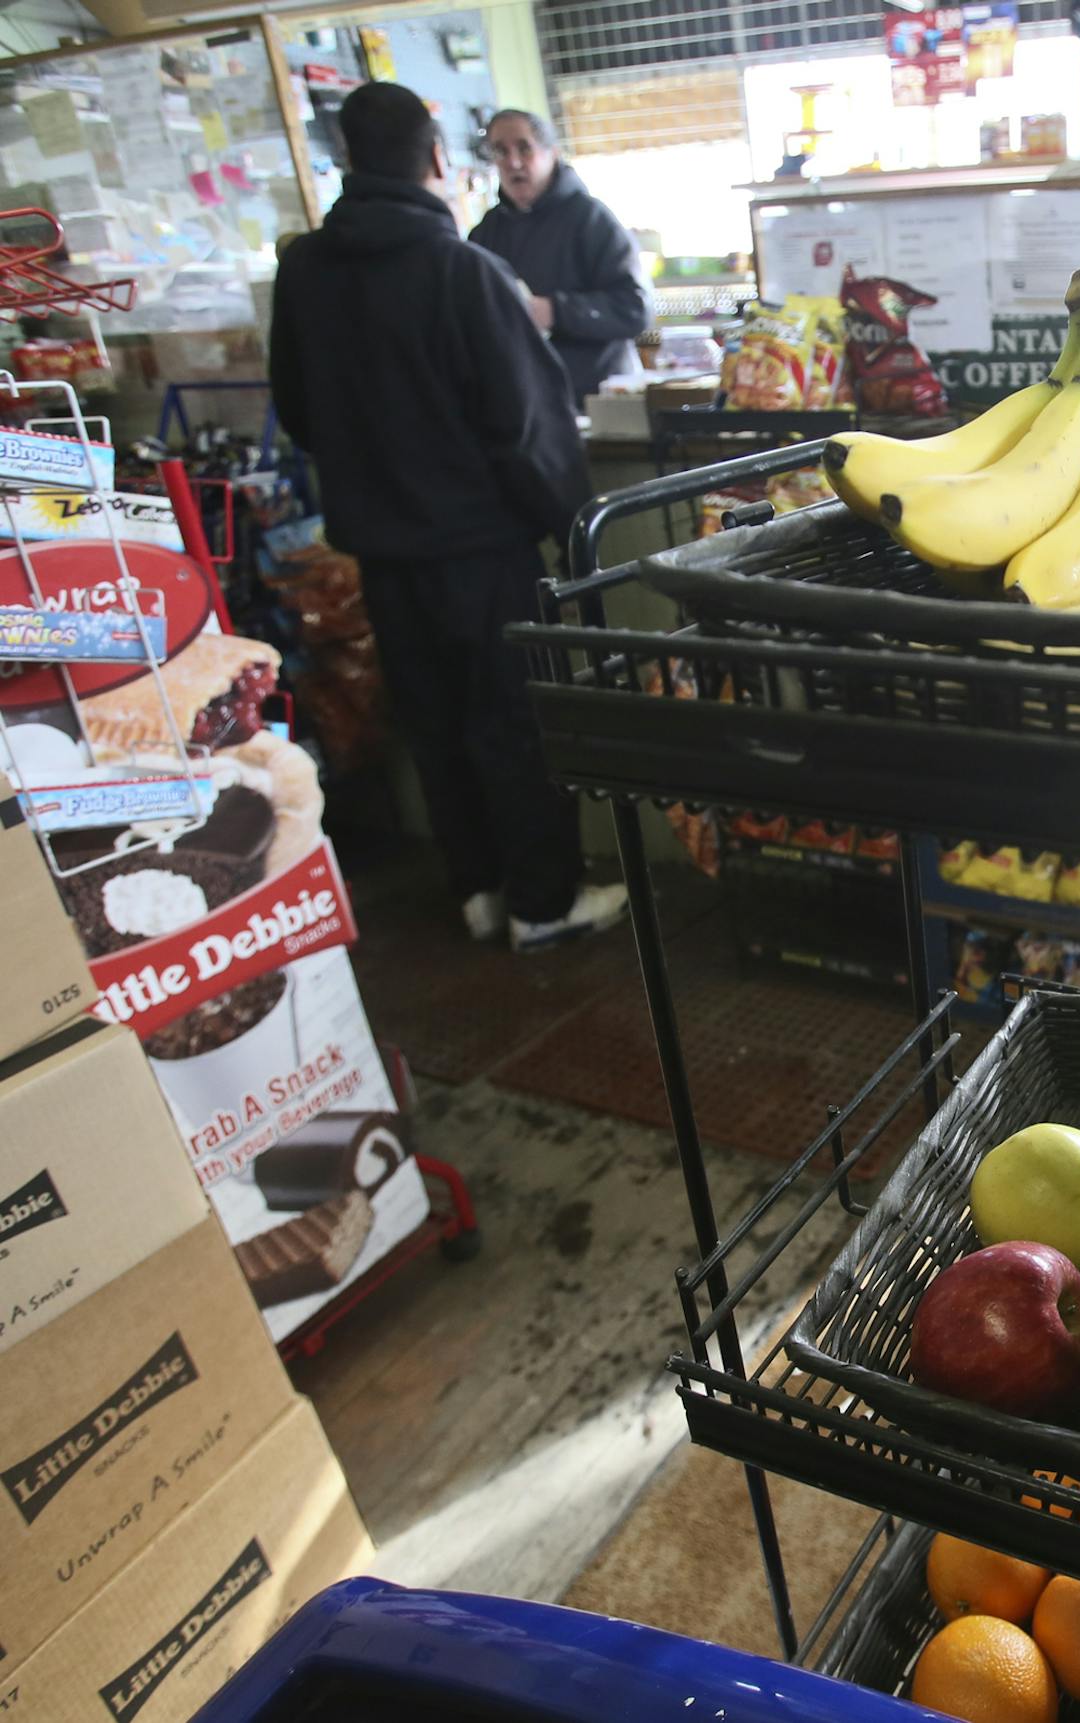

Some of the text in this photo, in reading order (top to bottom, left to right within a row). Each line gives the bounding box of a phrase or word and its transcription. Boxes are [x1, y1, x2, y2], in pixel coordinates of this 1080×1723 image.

[993, 328, 1069, 353] NTA
[940, 360, 1053, 386] COFFE
[28, 576, 141, 613] wrap
[284, 916, 341, 954] Snacks
[93, 889, 337, 1025] ittle Debbie
[42, 983, 81, 1014] 5210
[190, 1043, 346, 1155] rab A Snack
[194, 1068, 362, 1185] ith your Beverage
[0, 1191, 53, 1233] bbie
[11, 1305, 27, 1324] A
[13, 1354, 186, 1504] Little Debbie
[56, 1502, 144, 1583] Unwrap
[151, 1474, 170, 1502] A
[110, 1555, 263, 1714] Little Debbie
